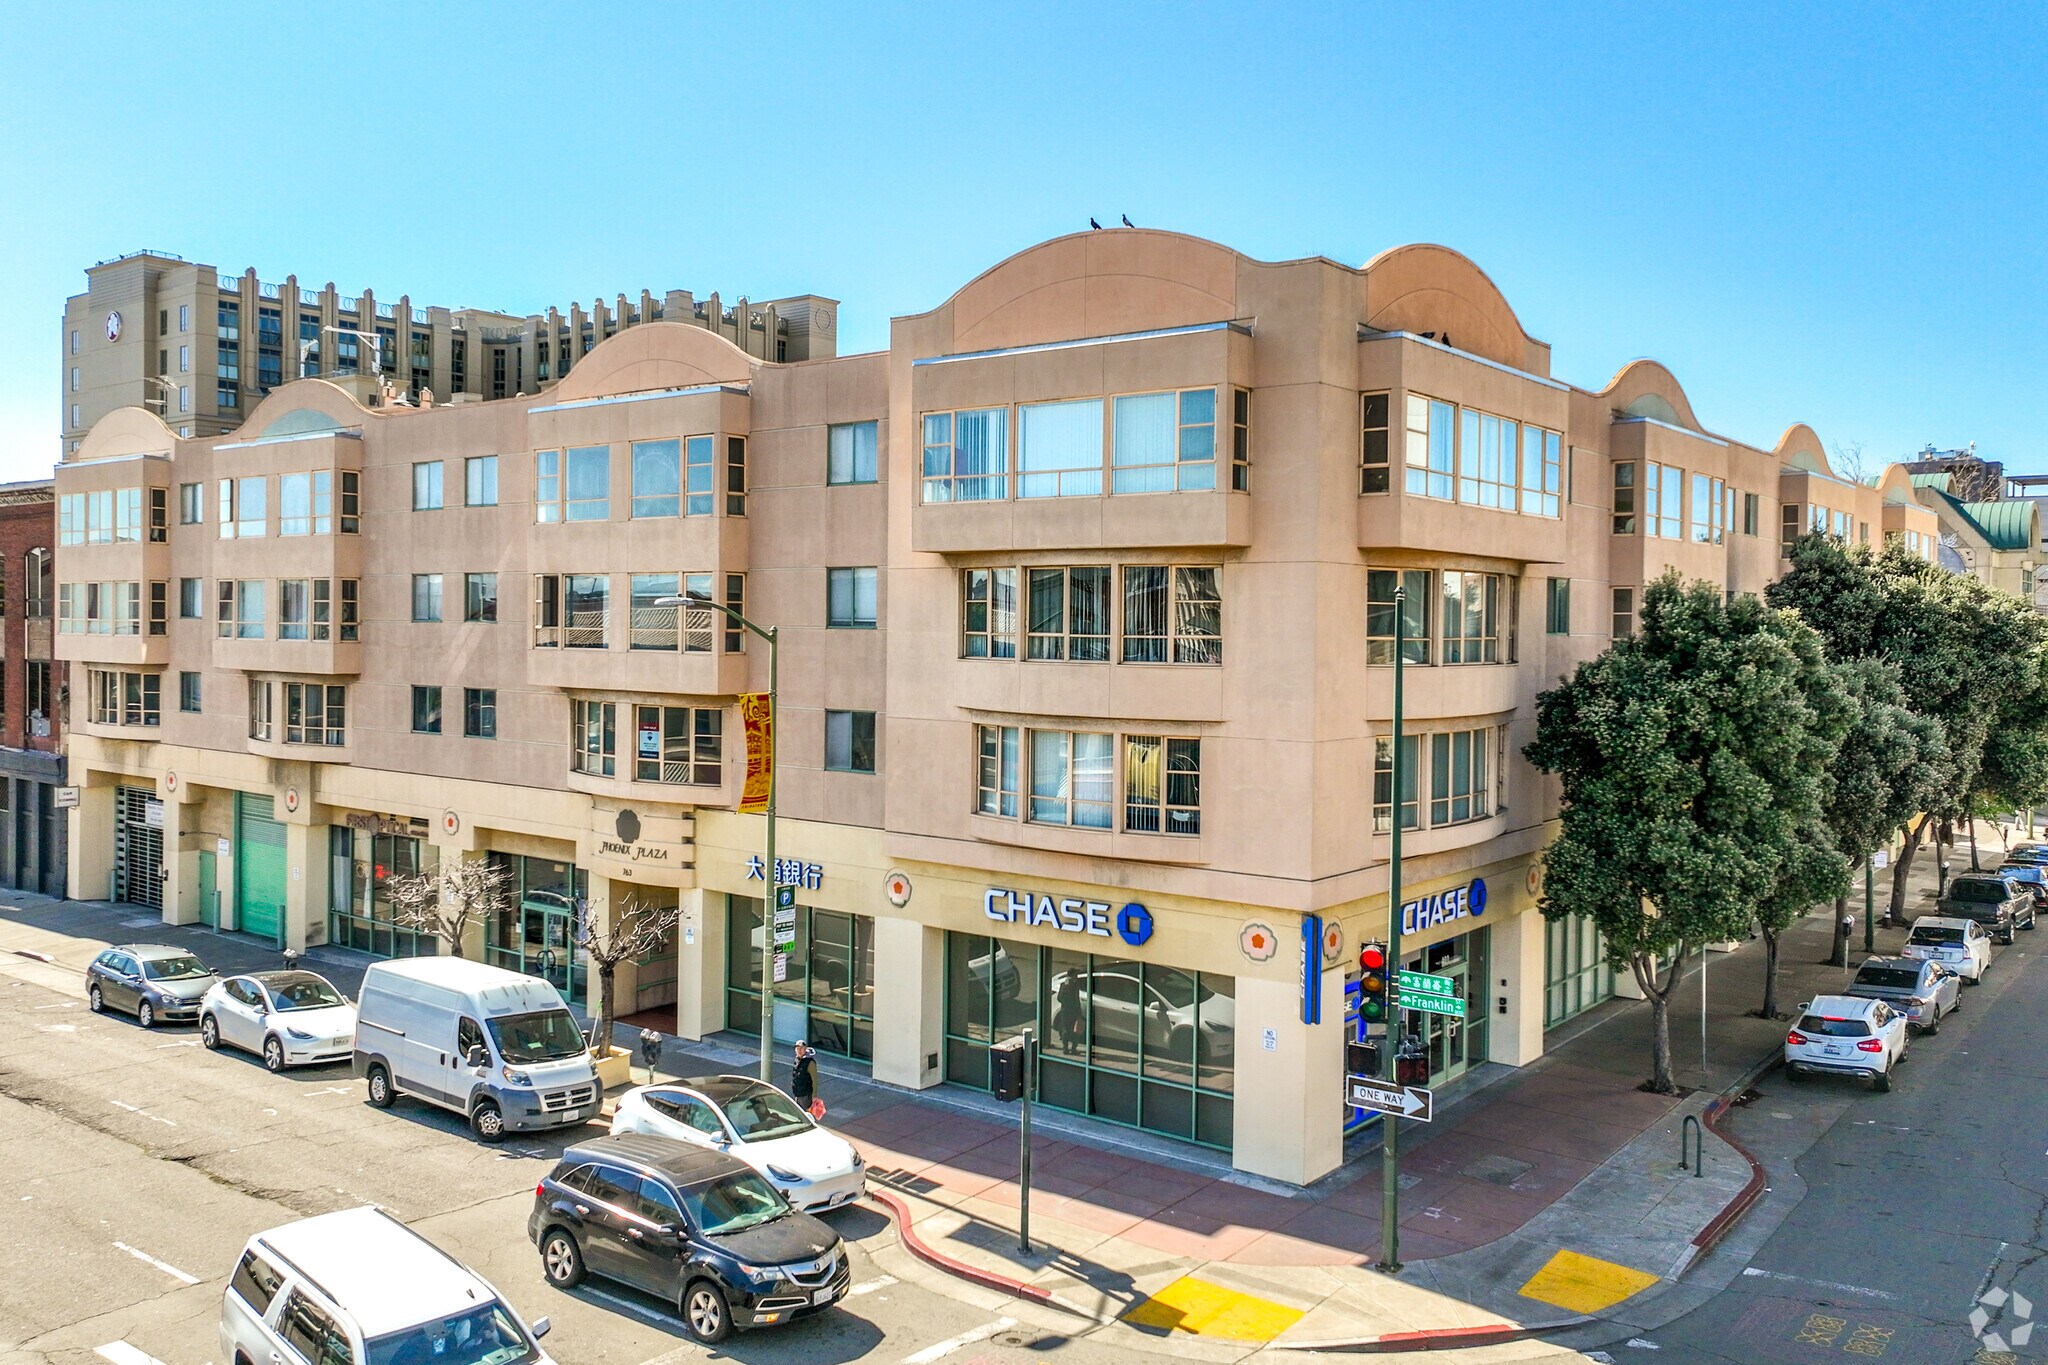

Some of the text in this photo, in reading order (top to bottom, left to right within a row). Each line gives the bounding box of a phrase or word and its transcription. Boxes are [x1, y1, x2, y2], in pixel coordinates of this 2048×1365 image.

[599, 841, 668, 861] PHOENIX PLAZA
[622, 868, 633, 876] 763
[984, 888, 1112, 937] CHASE
[1400, 886, 1469, 936] CHASE
[1411, 995, 1454, 1012] Franklin
[1360, 1088, 1405, 1106] ONE WAY
